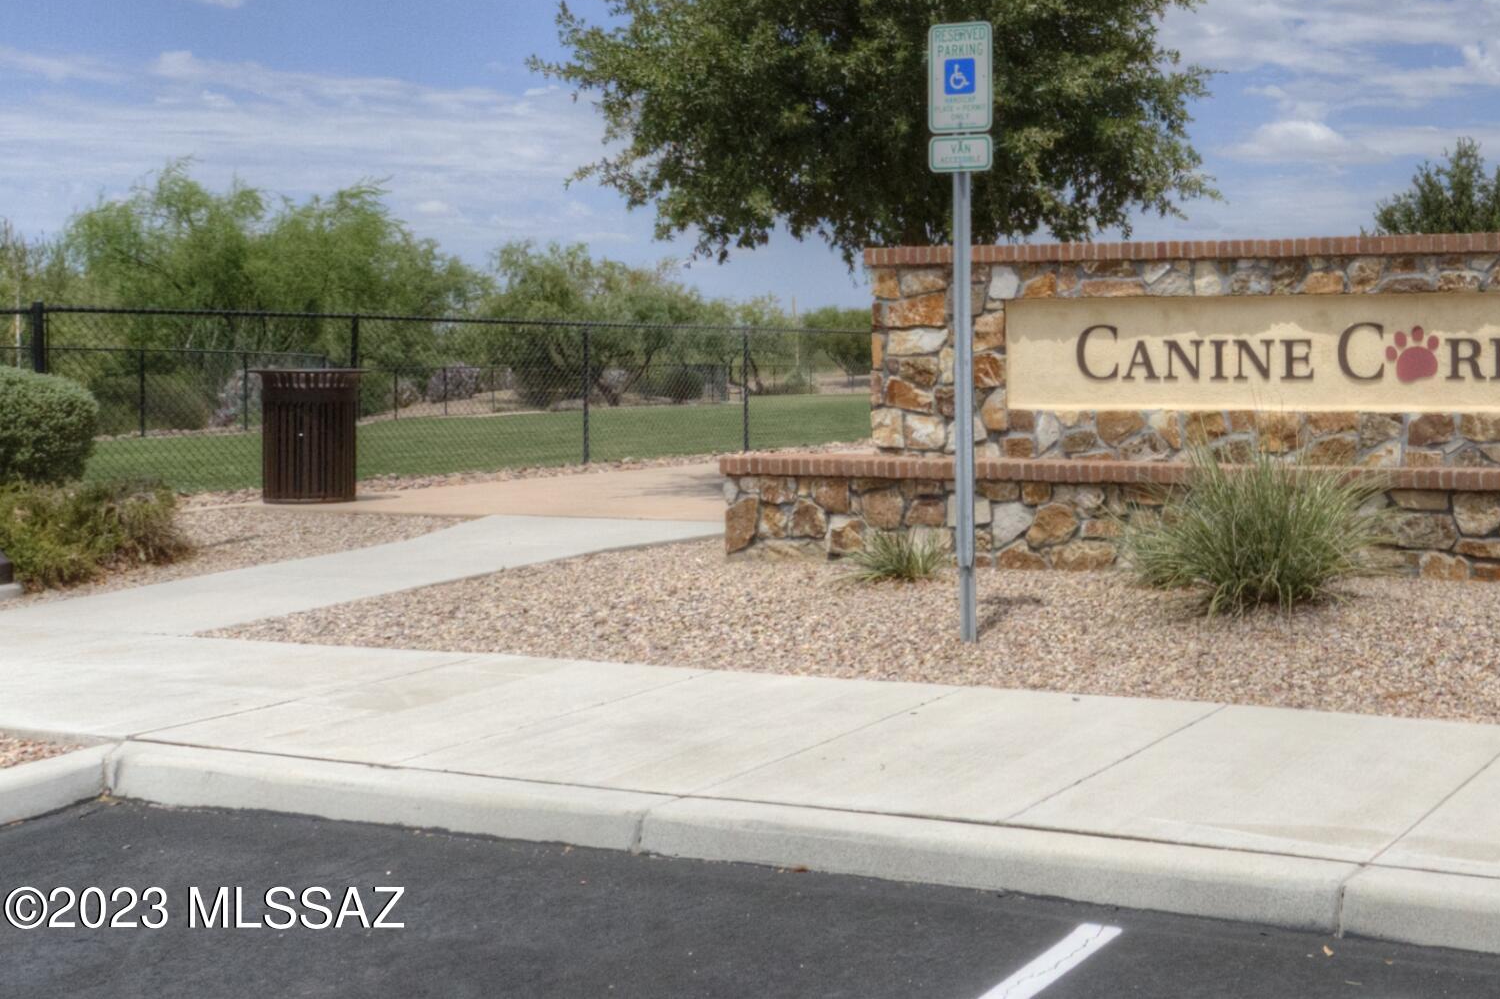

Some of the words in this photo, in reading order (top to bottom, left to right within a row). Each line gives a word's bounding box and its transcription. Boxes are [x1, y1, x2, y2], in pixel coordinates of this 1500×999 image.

[934, 27, 986, 43] RESERVED
[937, 43, 984, 58] PARKING
[951, 143, 971, 153] VAN
[1075, 324, 1315, 383] CANINE
